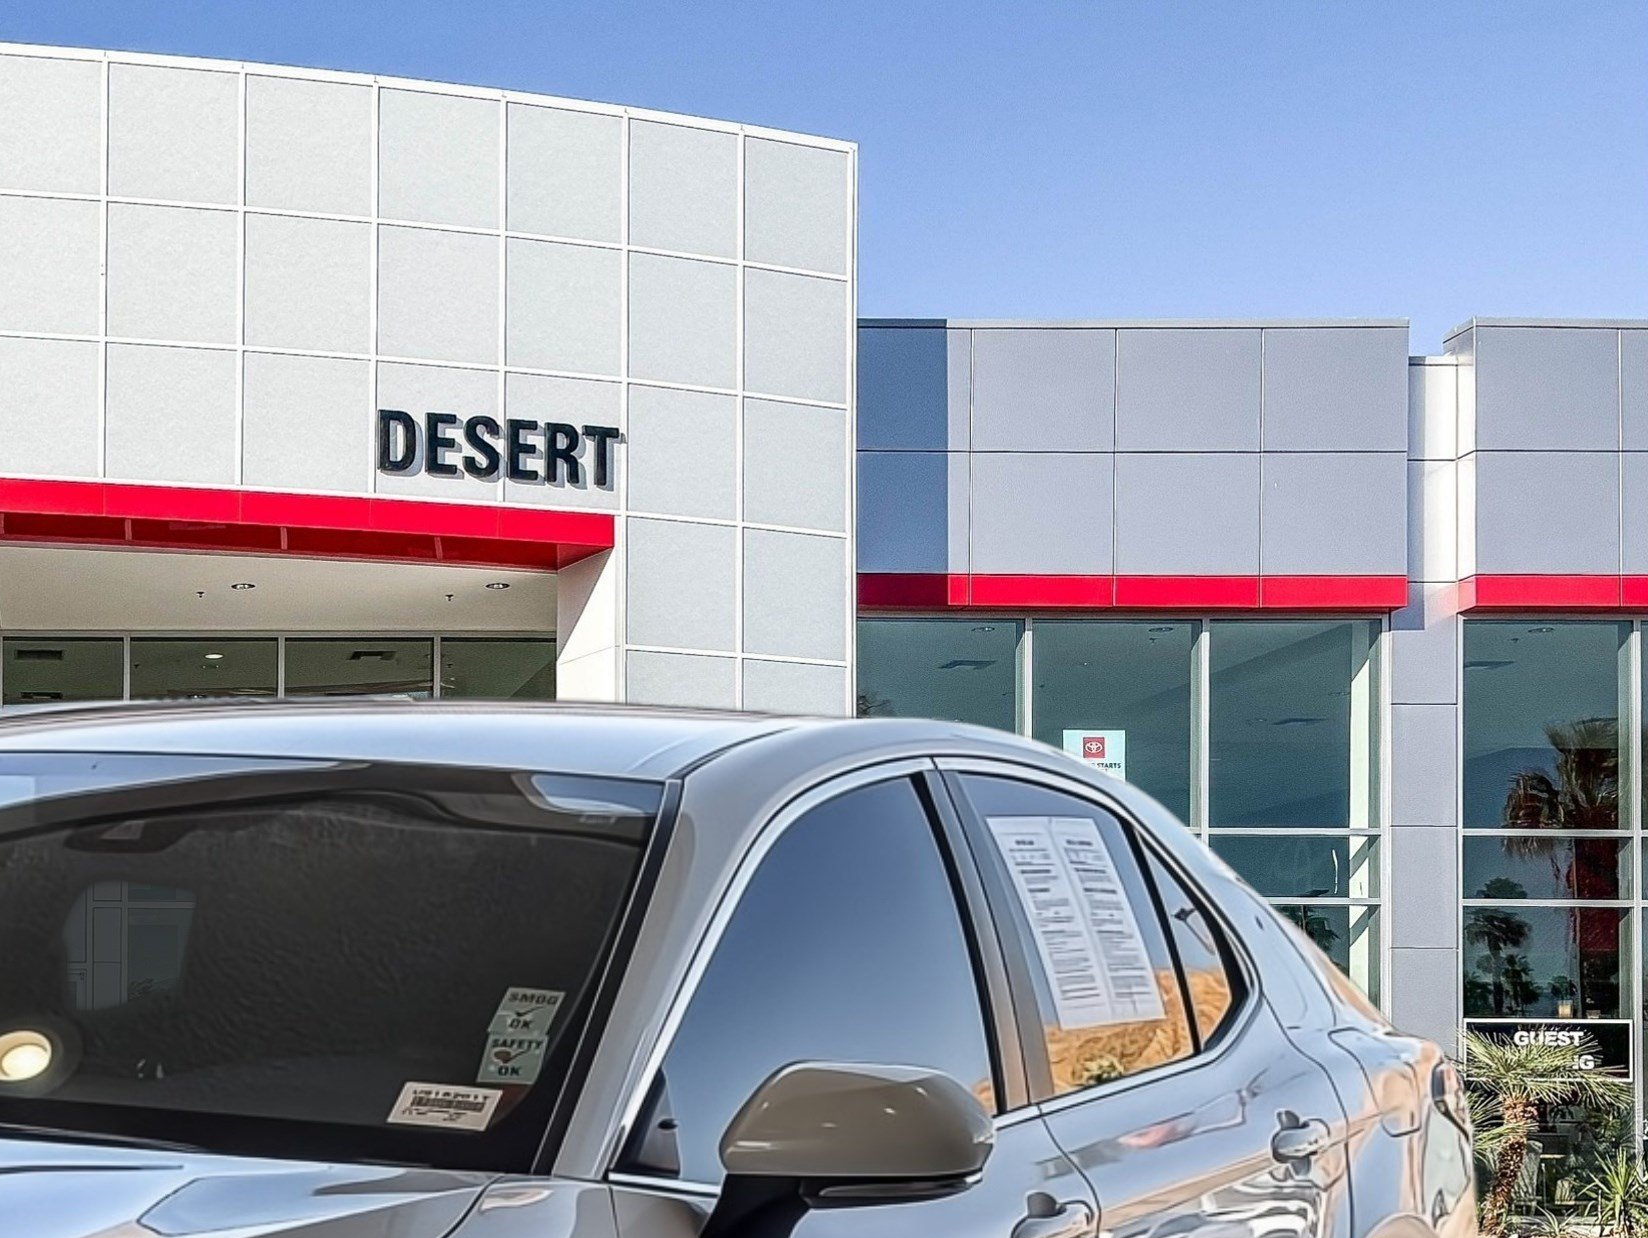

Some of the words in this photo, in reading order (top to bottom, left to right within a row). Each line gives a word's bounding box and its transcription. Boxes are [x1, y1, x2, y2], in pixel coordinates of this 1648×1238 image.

[377, 409, 620, 486] DESERT
[508, 993, 558, 1005] SMOG
[508, 1018, 533, 1029] OK
[491, 1038, 543, 1049] SAFETY
[1513, 1030, 1585, 1047] GUEST
[497, 1066, 521, 1076] OK
